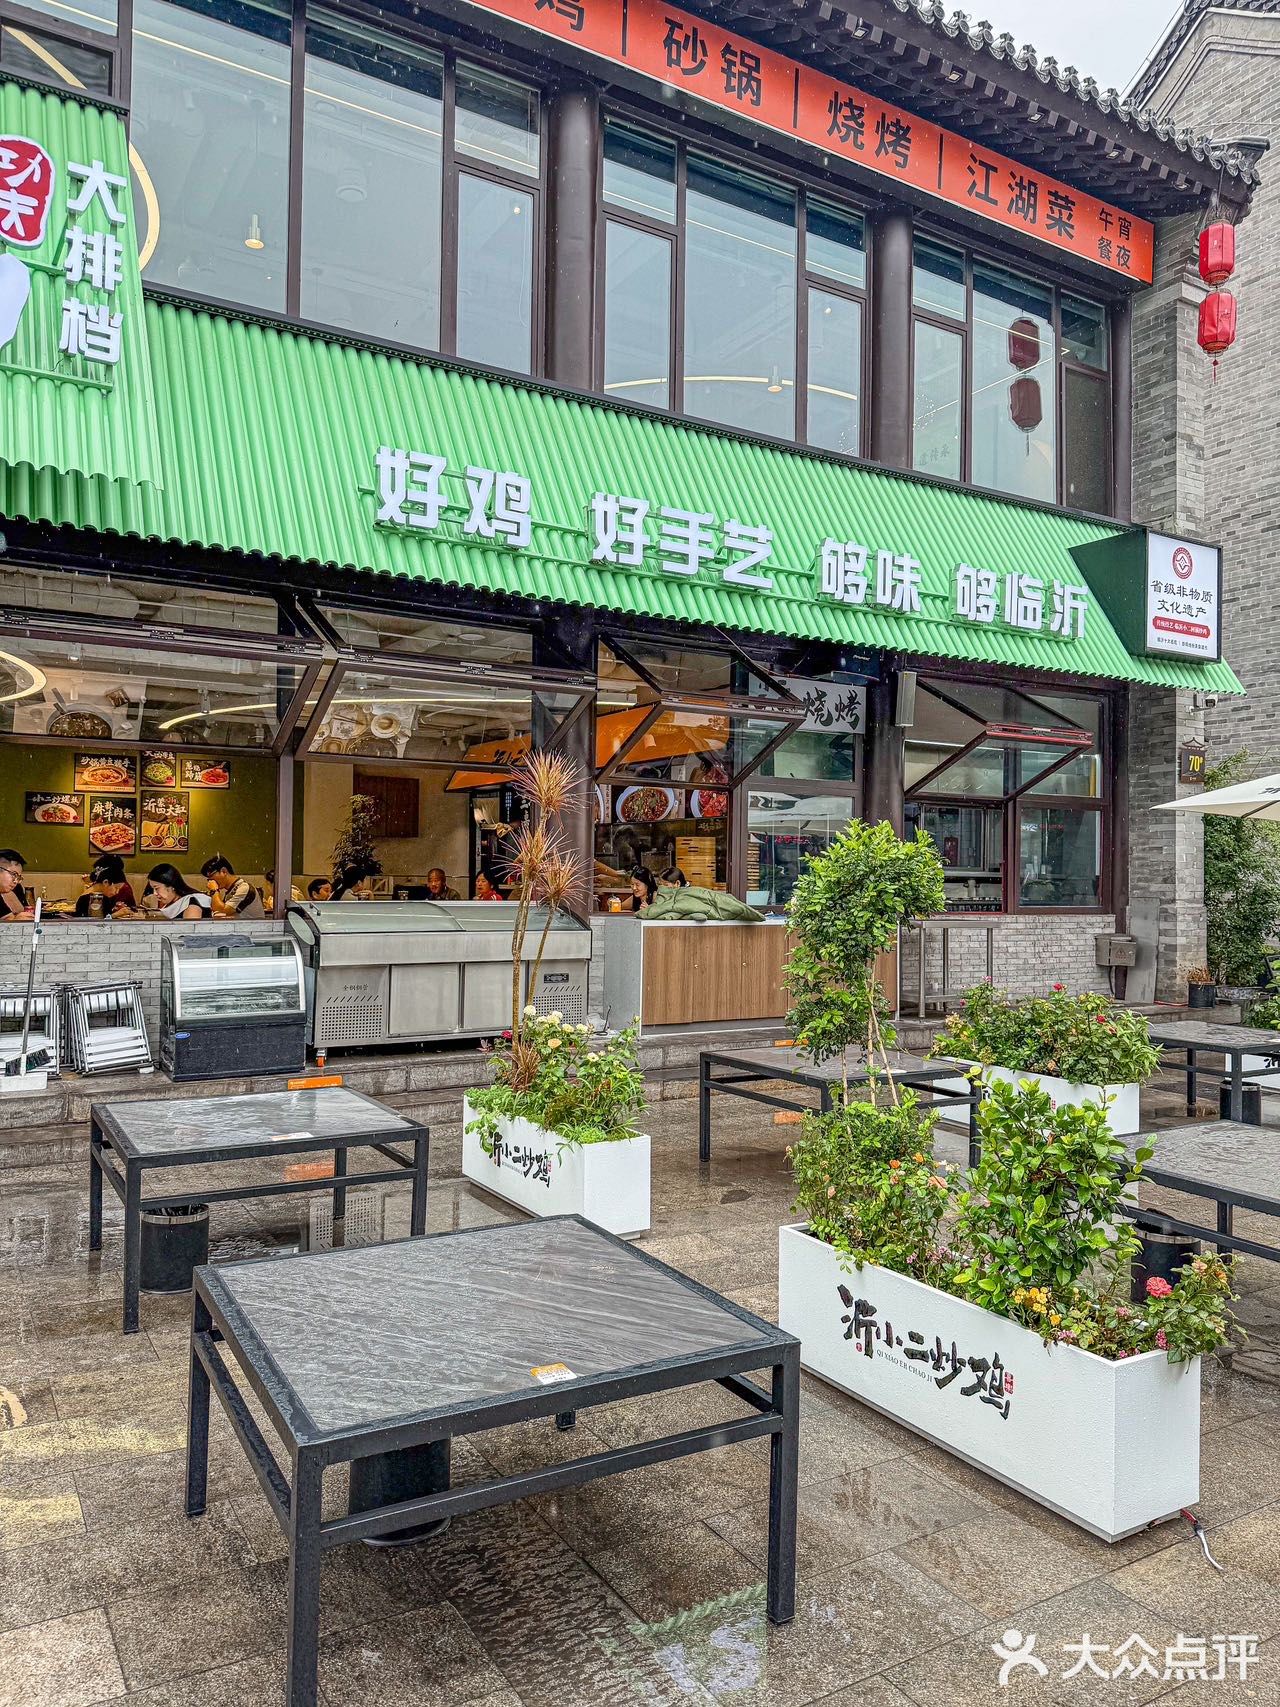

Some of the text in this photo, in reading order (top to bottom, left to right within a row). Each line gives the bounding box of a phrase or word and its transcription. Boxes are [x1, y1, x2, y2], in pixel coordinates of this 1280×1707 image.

[662, 16, 762, 107] 砂锅
[826, 91, 912, 169] 烧烤
[966, 152, 1077, 241] 江湖菜
[59, 159, 128, 364] 大排档
[374, 445, 1089, 639] 好鸡 好手艺 够味 够临沂
[1150, 580, 1213, 604] 省级非物质
[1157, 599, 1207, 618] 文化遗产
[801, 687, 861, 730] 烧烤
[837, 1284, 1010, 1420] 沂小二炒鸡
